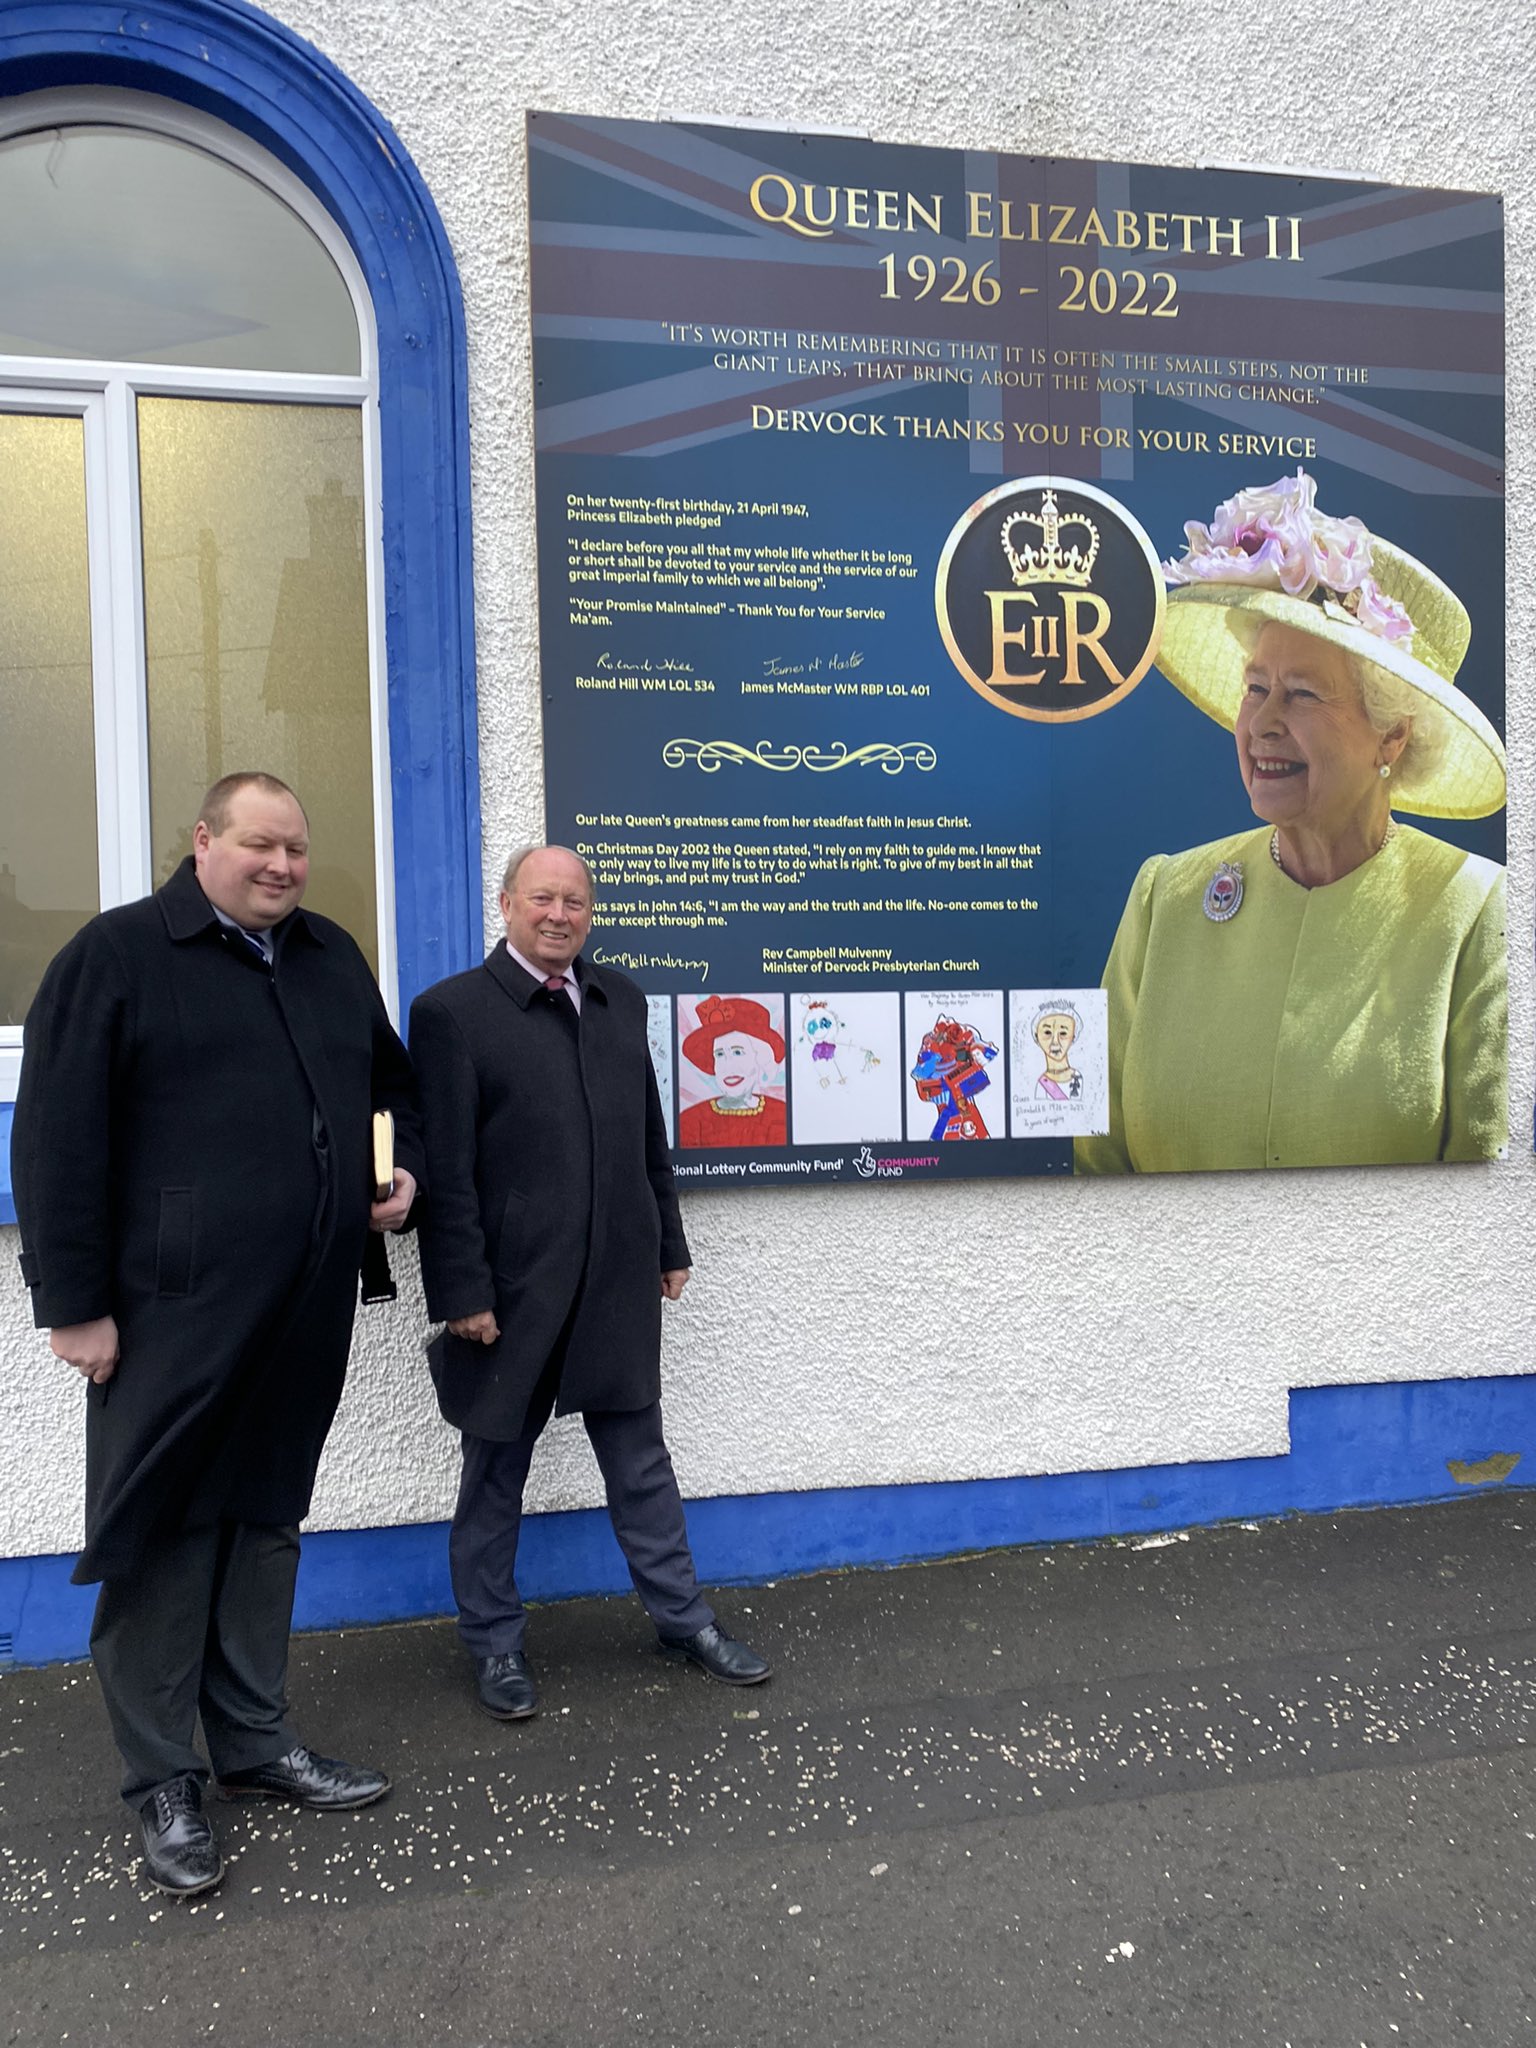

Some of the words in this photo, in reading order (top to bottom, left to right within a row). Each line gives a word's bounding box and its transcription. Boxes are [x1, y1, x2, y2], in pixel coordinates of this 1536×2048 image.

[750, 174, 944, 237] QUEEN
[967, 193, 1246, 257] ELIZABETH
[1265, 215, 1305, 261] II
[878, 252, 1003, 306] 1926
[1058, 265, 1180, 317] 2022
[711, 327, 788, 349] WORTH
[797, 333, 941, 358] REMEMBERING
[947, 342, 998, 362] THAT
[1006, 346, 1024, 364] IT
[1031, 348, 1047, 365] IS
[1054, 350, 1116, 369] OFTEN
[1122, 353, 1159, 372] THE
[1165, 356, 1223, 376] SMALL
[1229, 360, 1284, 381] STEPS,
[1290, 364, 1330, 382] NOT
[1334, 366, 1370, 384] THE
[714, 353, 780, 373] GIANT
[787, 357, 847, 378] LEAPS,
[853, 361, 906, 381] THAT
[913, 365, 973, 385] BRING
[980, 369, 1045, 389] ABOUT
[1052, 373, 1088, 392] THE
[1096, 376, 1148, 395] MOST
[1156, 379, 1232, 400] LASTING
[752, 405, 887, 436] DERVOCK
[893, 415, 1005, 442] THANKS
[1013, 422, 1069, 446] YOU
[1081, 426, 1131, 449] FOR
[1138, 429, 1211, 453] YOUR
[1218, 433, 1317, 459] SERVICE
[566, 494, 585, 506] On
[587, 494, 607, 507] her
[609, 496, 681, 512] twenty-first
[683, 498, 735, 515] birthday,
[737, 501, 749, 513] 21
[751, 502, 779, 517] April
[781, 504, 809, 518] 1947,
[567, 508, 617, 522] Princess
[618, 511, 673, 525] Elizabeth
[675, 513, 722, 529] pledged
[581, 538, 624, 552] declare
[626, 540, 665, 554] before
[666, 544, 689, 558] you
[690, 543, 705, 555] all
[706, 543, 732, 557] that
[733, 547, 752, 560] my
[753, 545, 789, 559] whole
[791, 546, 810, 560] life
[811, 548, 859, 561] whether
[861, 549, 870, 562] it
[871, 549, 886, 562] be
[888, 550, 913, 566] long
[568, 555, 582, 565] or
[583, 553, 616, 567] short
[617, 554, 645, 568] shall
[647, 555, 663, 568] be
[664, 557, 712, 570] devoted
[713, 558, 727, 571] to
[728, 561, 756, 574] your
[757, 560, 798, 574] service
[799, 561, 821, 574] and
[822, 562, 842, 575] the
[843, 563, 883, 577] service
[884, 564, 897, 577] of
[898, 567, 918, 578] our
[568, 569, 601, 583] great
[603, 568, 651, 584] imperial
[652, 570, 689, 586] family
[691, 572, 704, 585] to
[706, 572, 741, 586] which
[743, 577, 761, 587] we
[763, 574, 777, 587] all
[606, 598, 654, 612] Promise
[737, 603, 773, 616] Thank
[774, 604, 797, 617] You
[798, 604, 816, 617] for
[817, 606, 844, 618] Your
[845, 606, 886, 619] Service
[570, 612, 613, 625] Ma'am.
[575, 676, 617, 689] Roland
[619, 677, 639, 690] Hill
[640, 678, 667, 690] WM
[669, 679, 693, 691] LOL
[694, 679, 716, 692] 534
[741, 681, 775, 694] James
[776, 681, 832, 694] McMaster
[834, 683, 859, 695] WM
[860, 683, 884, 695] RBP
[886, 684, 909, 696] LOL
[910, 684, 930, 696] 401
[575, 813, 599, 825] Our
[600, 813, 623, 826] late
[625, 813, 672, 827] Queen's
[673, 815, 729, 829] greatness
[731, 817, 761, 827] came
[762, 814, 790, 827] from
[792, 815, 811, 827] her
[812, 815, 864, 828] steadfast
[866, 815, 892, 828] faith
[894, 815, 905, 827] in
[906, 816, 935, 829] Jesus
[936, 815, 972, 828] Christ.
[576, 842, 594, 854] On
[596, 842, 654, 855] Christmas
[656, 843, 679, 857] Day
[681, 843, 711, 855] 2002
[712, 843, 732, 855] the
[733, 843, 770, 857] Queen
[772, 843, 811, 857] stated,
[825, 843, 847, 857] rely
[848, 846, 863, 855] on
[865, 846, 882, 858] my
[884, 843, 911, 855] faith
[912, 844, 925, 855] to
[926, 843, 957, 858] guide
[958, 846, 979, 855] me.
[986, 843, 1017, 855] know
[1018, 843, 1042, 855] that
[591, 914, 617, 926] ther
[618, 914, 657, 928] except
[658, 913, 705, 928] through
[707, 916, 728, 926] me.
[762, 948, 784, 959] Rev
[785, 946, 837, 961] Campbell
[838, 946, 893, 960] Mulvenny
[763, 960, 809, 973] Minister
[810, 960, 823, 973] of
[824, 960, 871, 973] Dervock
[872, 959, 941, 974] Presbyterian
[942, 959, 980, 971] Church
[672, 1163, 703, 1176] ional
[705, 1163, 747, 1176] Lottery
[748, 1159, 812, 1174] Community
[877, 1156, 941, 1168] COMMUNITY
[877, 1166, 904, 1177] FUND
